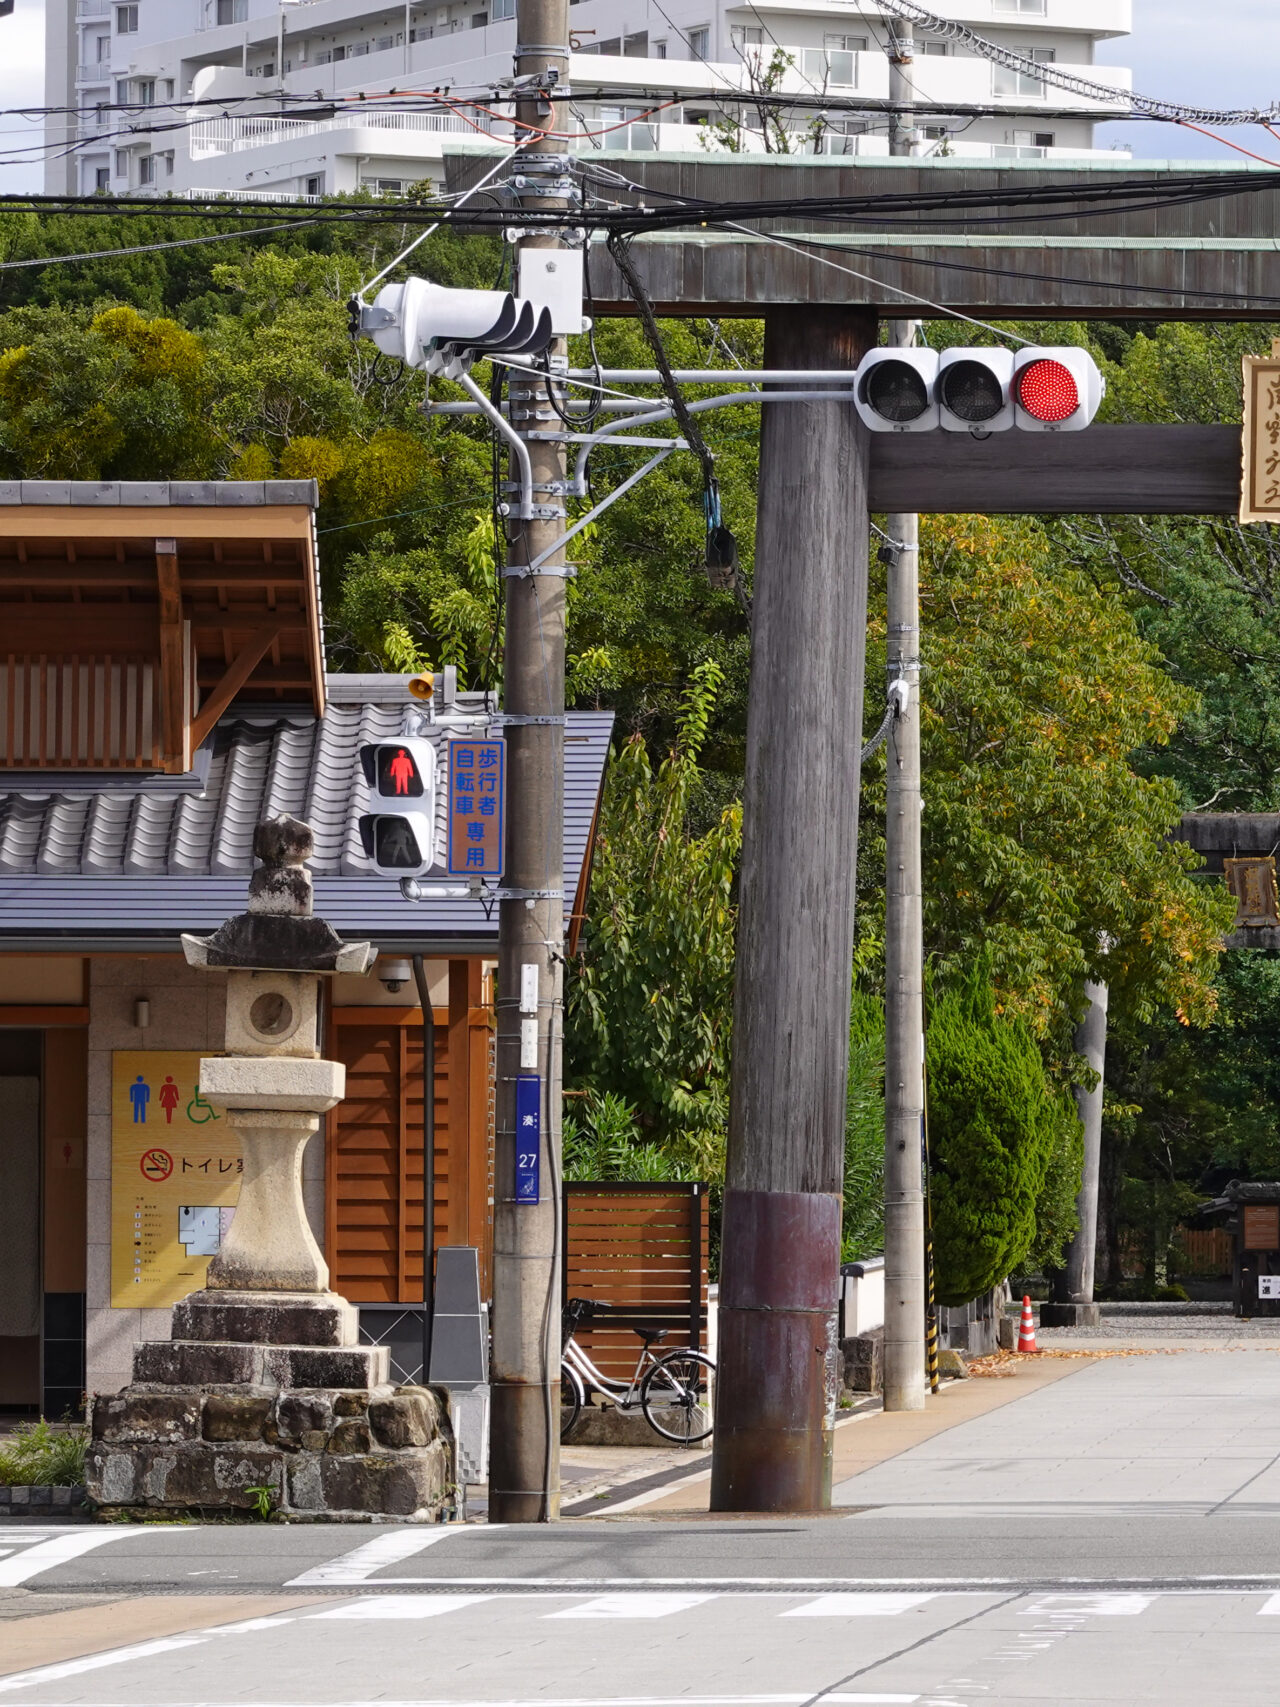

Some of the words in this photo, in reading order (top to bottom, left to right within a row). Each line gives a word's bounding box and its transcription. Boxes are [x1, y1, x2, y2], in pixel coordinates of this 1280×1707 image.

[455, 748, 475, 816] 自転車
[478, 748, 498, 816] 歩行者
[466, 821, 485, 867] 専用
[519, 1153, 537, 1168] 27
